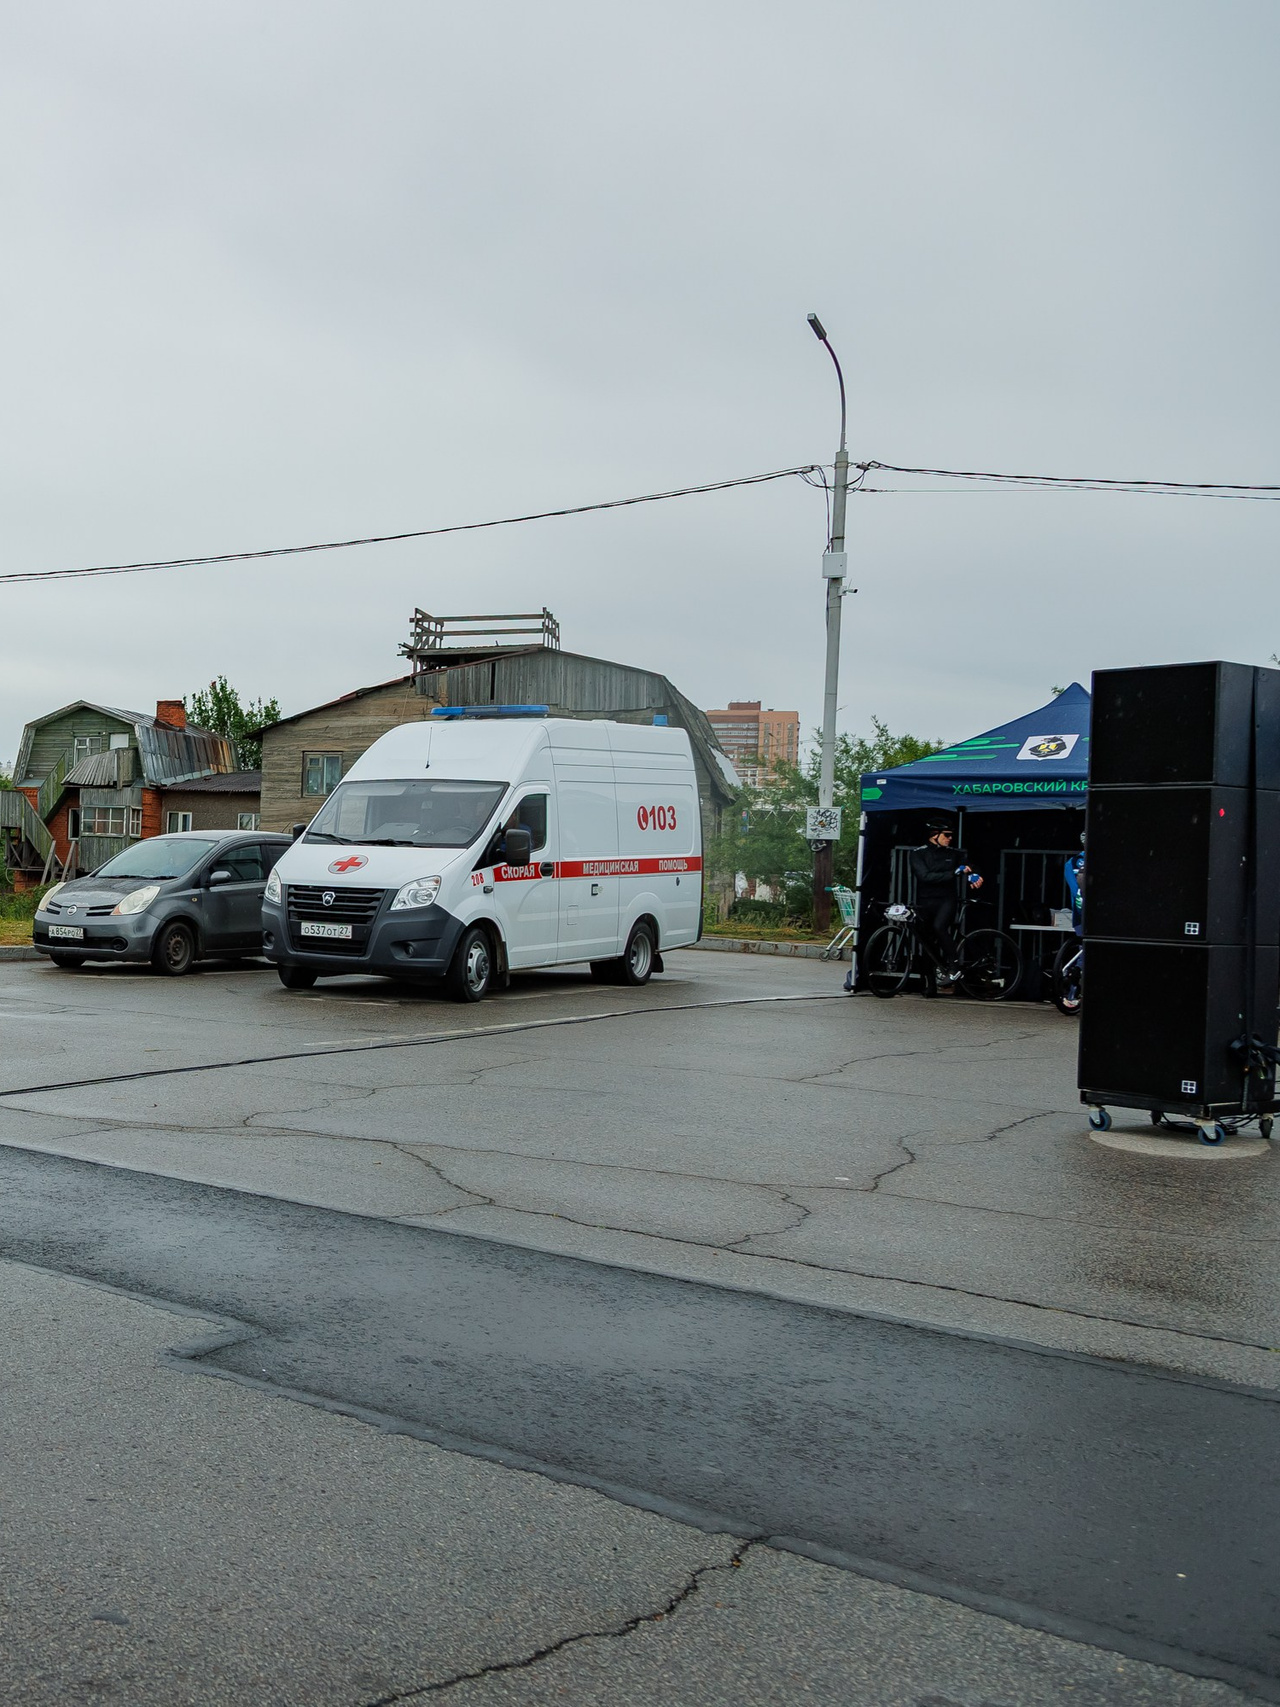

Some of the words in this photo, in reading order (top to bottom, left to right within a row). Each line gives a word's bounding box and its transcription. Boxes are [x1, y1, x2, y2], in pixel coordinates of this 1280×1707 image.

[952, 779, 1067, 795] ХАБАРОВСКИЙ
[649, 805, 677, 831] 103
[501, 864, 535, 879] СКОРАЯ
[582, 860, 639, 876] МЕДИЦИНСКАЯ
[659, 859, 688, 872] ПОМОЩЬ
